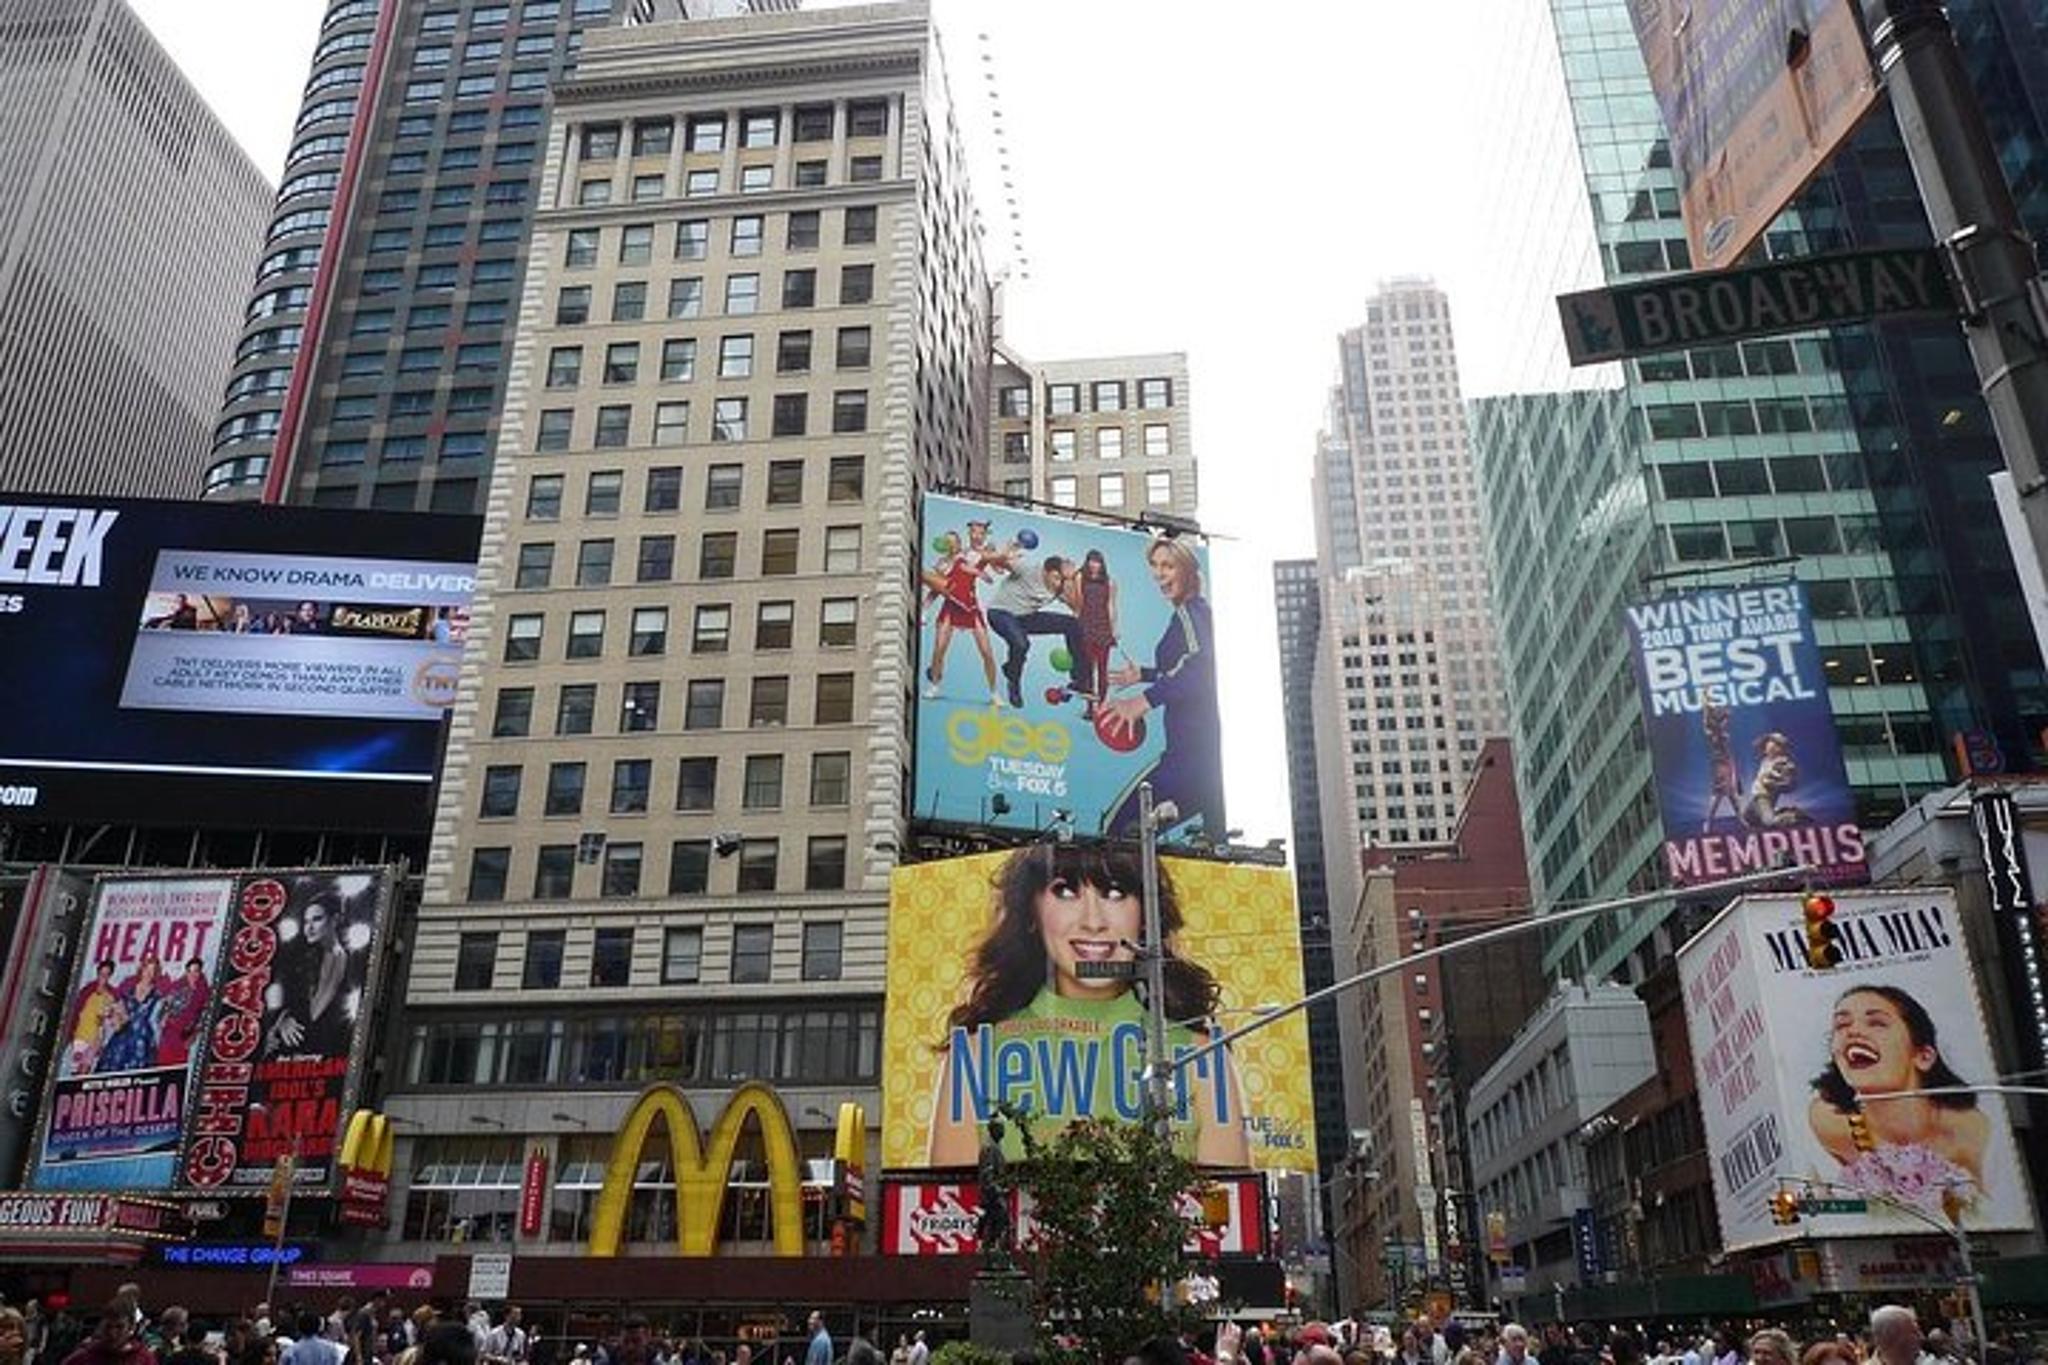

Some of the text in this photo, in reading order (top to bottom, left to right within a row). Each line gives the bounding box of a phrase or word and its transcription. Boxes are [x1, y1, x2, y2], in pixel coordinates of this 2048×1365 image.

[1633, 255, 1931, 346] BROADWAY
[173, 566, 209, 581] WE
[213, 567, 282, 584] KNOW
[287, 570, 365, 587] DRAMA
[1628, 586, 1802, 630] WINNER!
[1641, 611, 1799, 649] 2010 TONY AWARD
[1644, 632, 1804, 690] BEST
[1652, 676, 1816, 716] MUSICAL
[946, 705, 1073, 768] glee
[1665, 823, 1865, 878] MEMPHIS
[93, 920, 214, 964] HEART
[1878, 906, 1951, 956] MIA!
[185, 878, 287, 1188] CHICAGO
[950, 1020, 1229, 1124] New Grl
[54, 1081, 178, 1130] PRISCILLA
[59, 1199, 101, 1224] FUN!
[164, 1248, 188, 1262] THE
[192, 1248, 247, 1264] CHANGE
